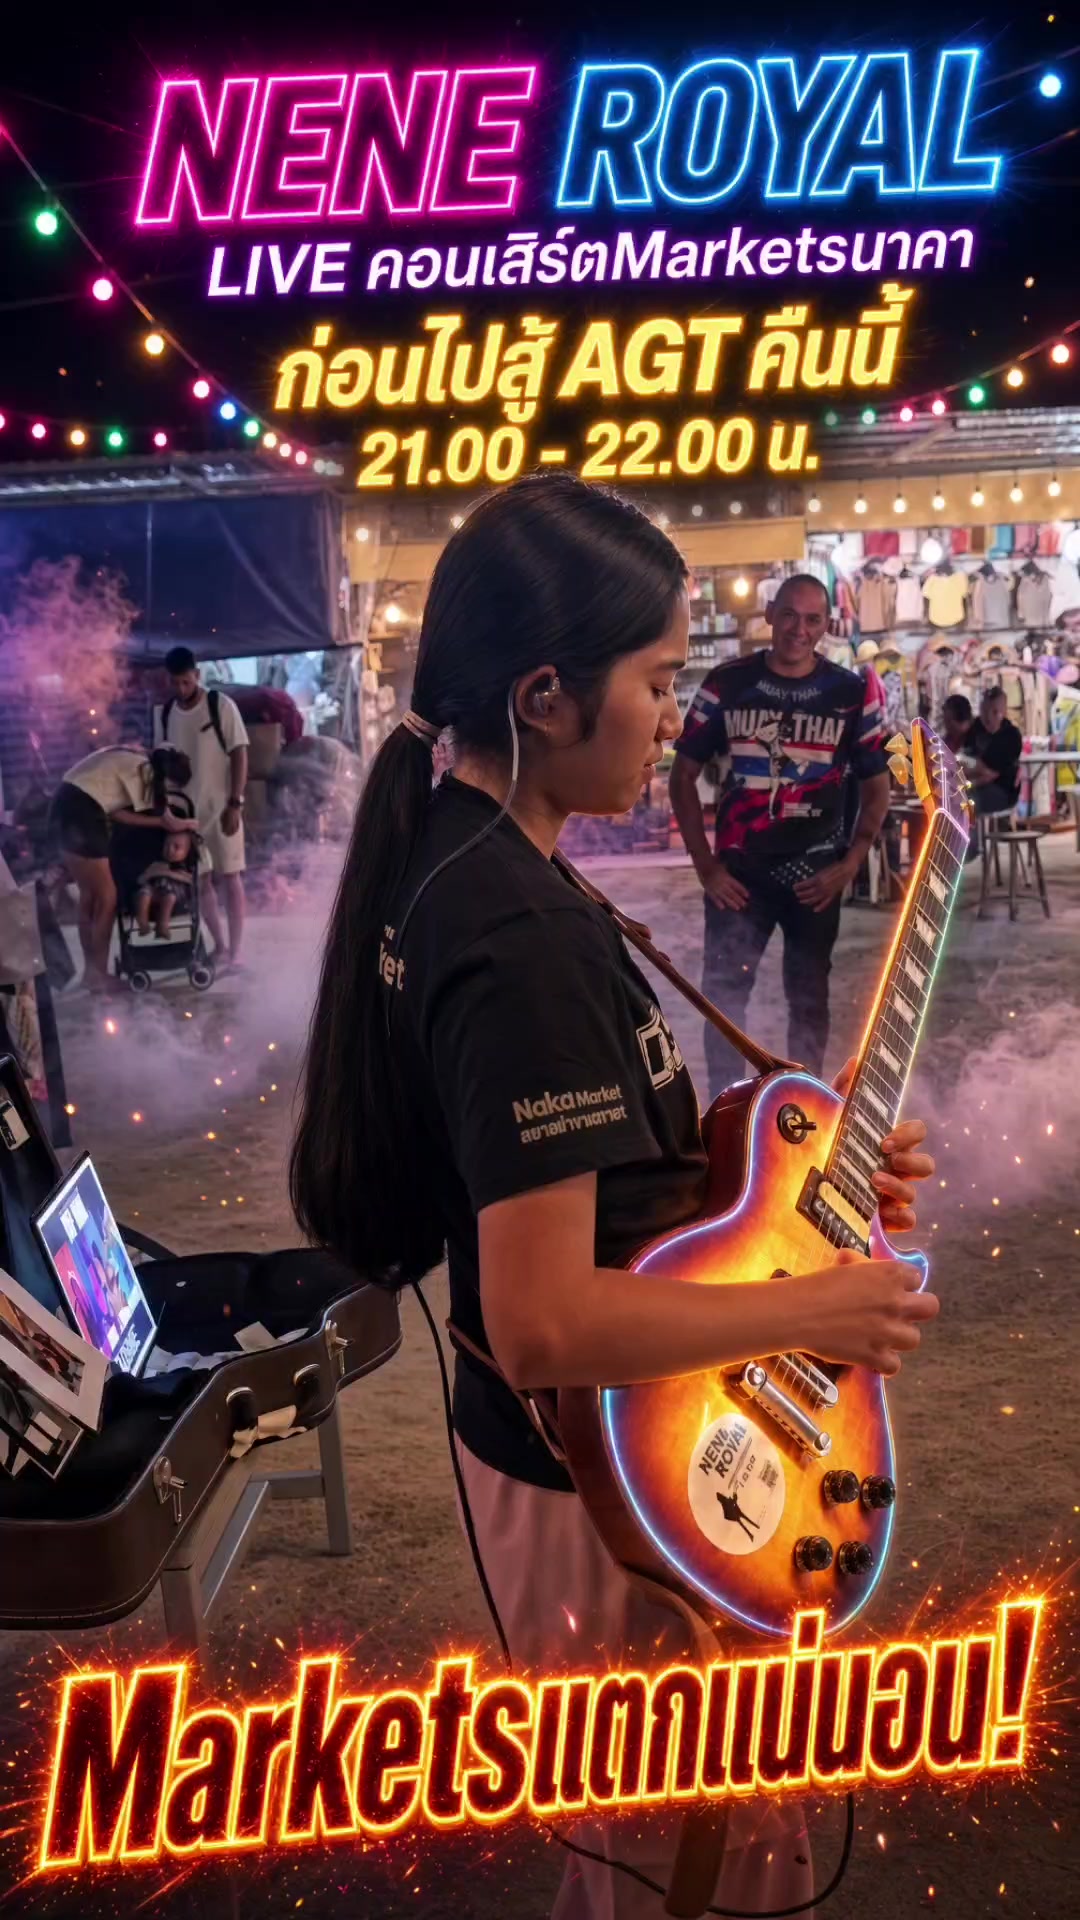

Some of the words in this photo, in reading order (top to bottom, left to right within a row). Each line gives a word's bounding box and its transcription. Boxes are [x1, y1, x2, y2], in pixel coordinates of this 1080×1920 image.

[756, 680, 788, 700] MUAY
[791, 711, 847, 746] THAI
[511, 1091, 577, 1123] Naka
[575, 1084, 623, 1108] Market
